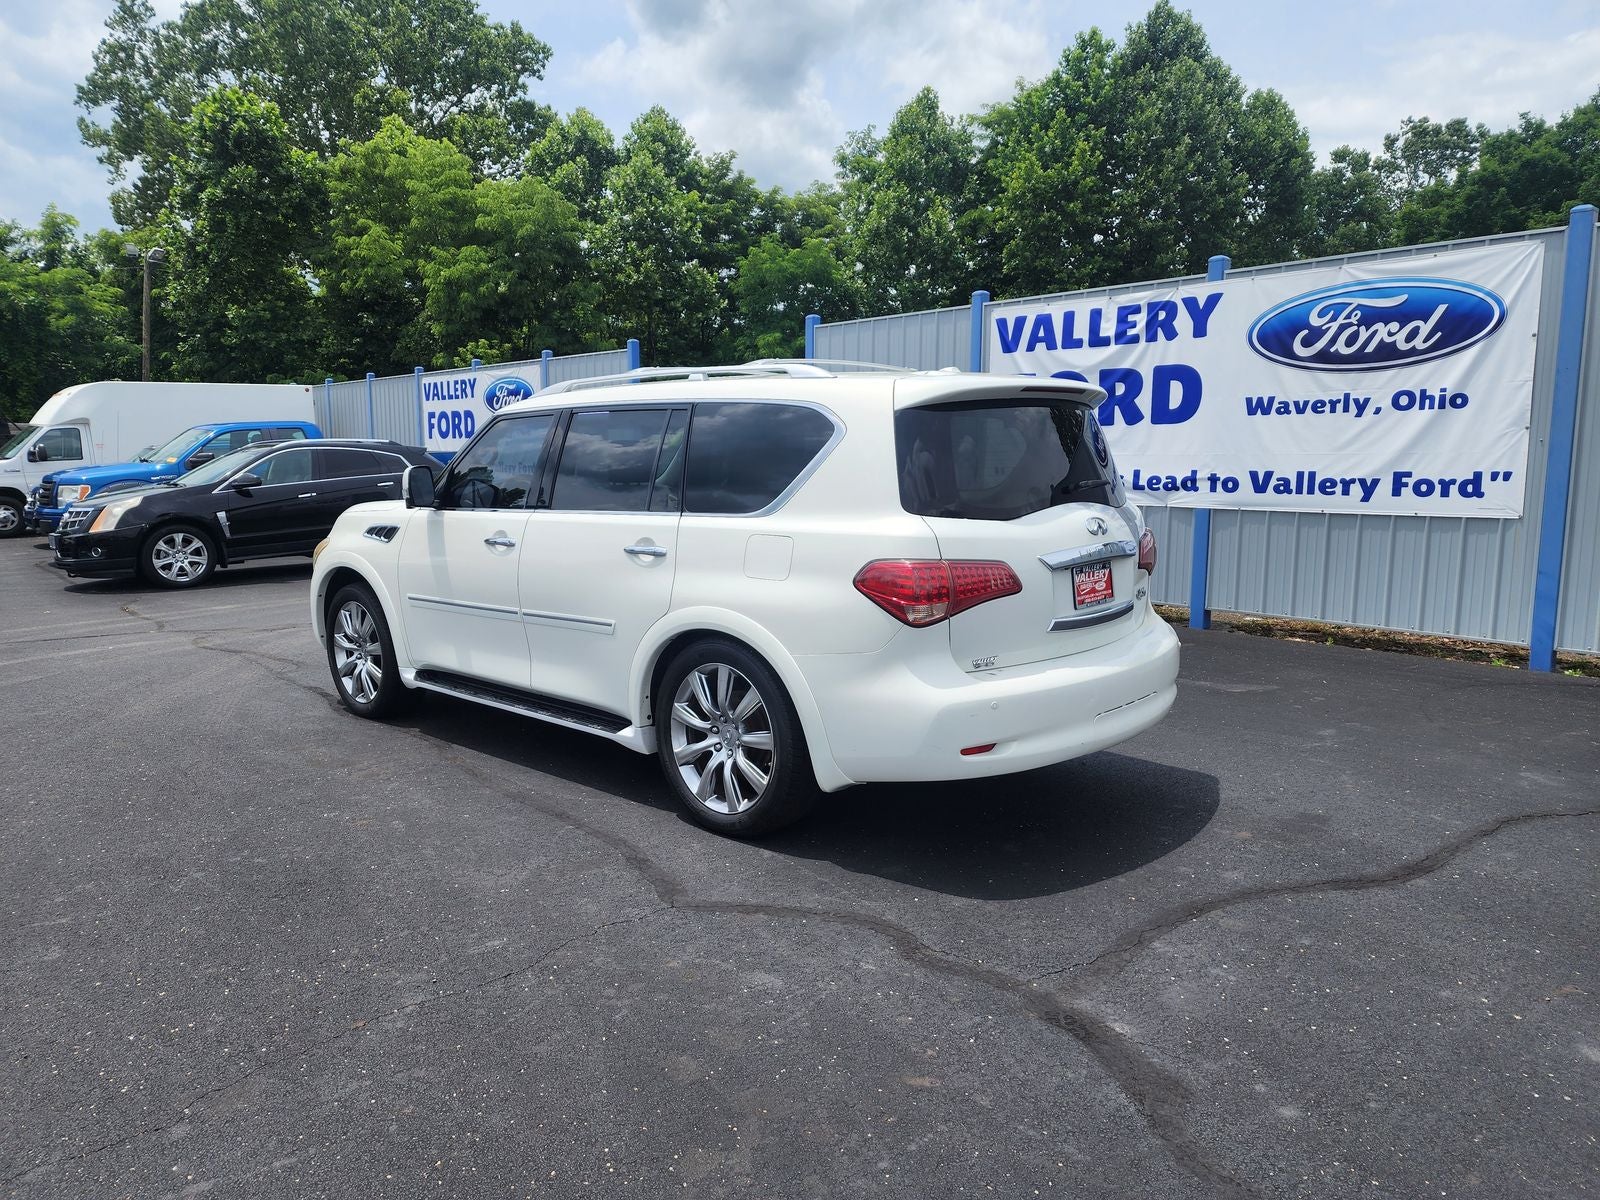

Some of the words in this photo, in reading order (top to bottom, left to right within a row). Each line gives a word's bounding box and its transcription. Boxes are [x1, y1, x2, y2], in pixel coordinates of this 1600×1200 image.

[995, 292, 1224, 354] VALLERY
[1292, 293, 1449, 357] Ford
[423, 377, 477, 402] VALLERY
[1012, 363, 1203, 427] RD
[1245, 392, 1382, 418] Waverly,
[1391, 387, 1470, 411] Ohio
[427, 409, 476, 440] FORD
[1132, 469, 1200, 492] Lead
[1207, 472, 1240, 494] to
[1249, 470, 1381, 503] Vallery
[1075, 568, 1111, 583] VALLERY
